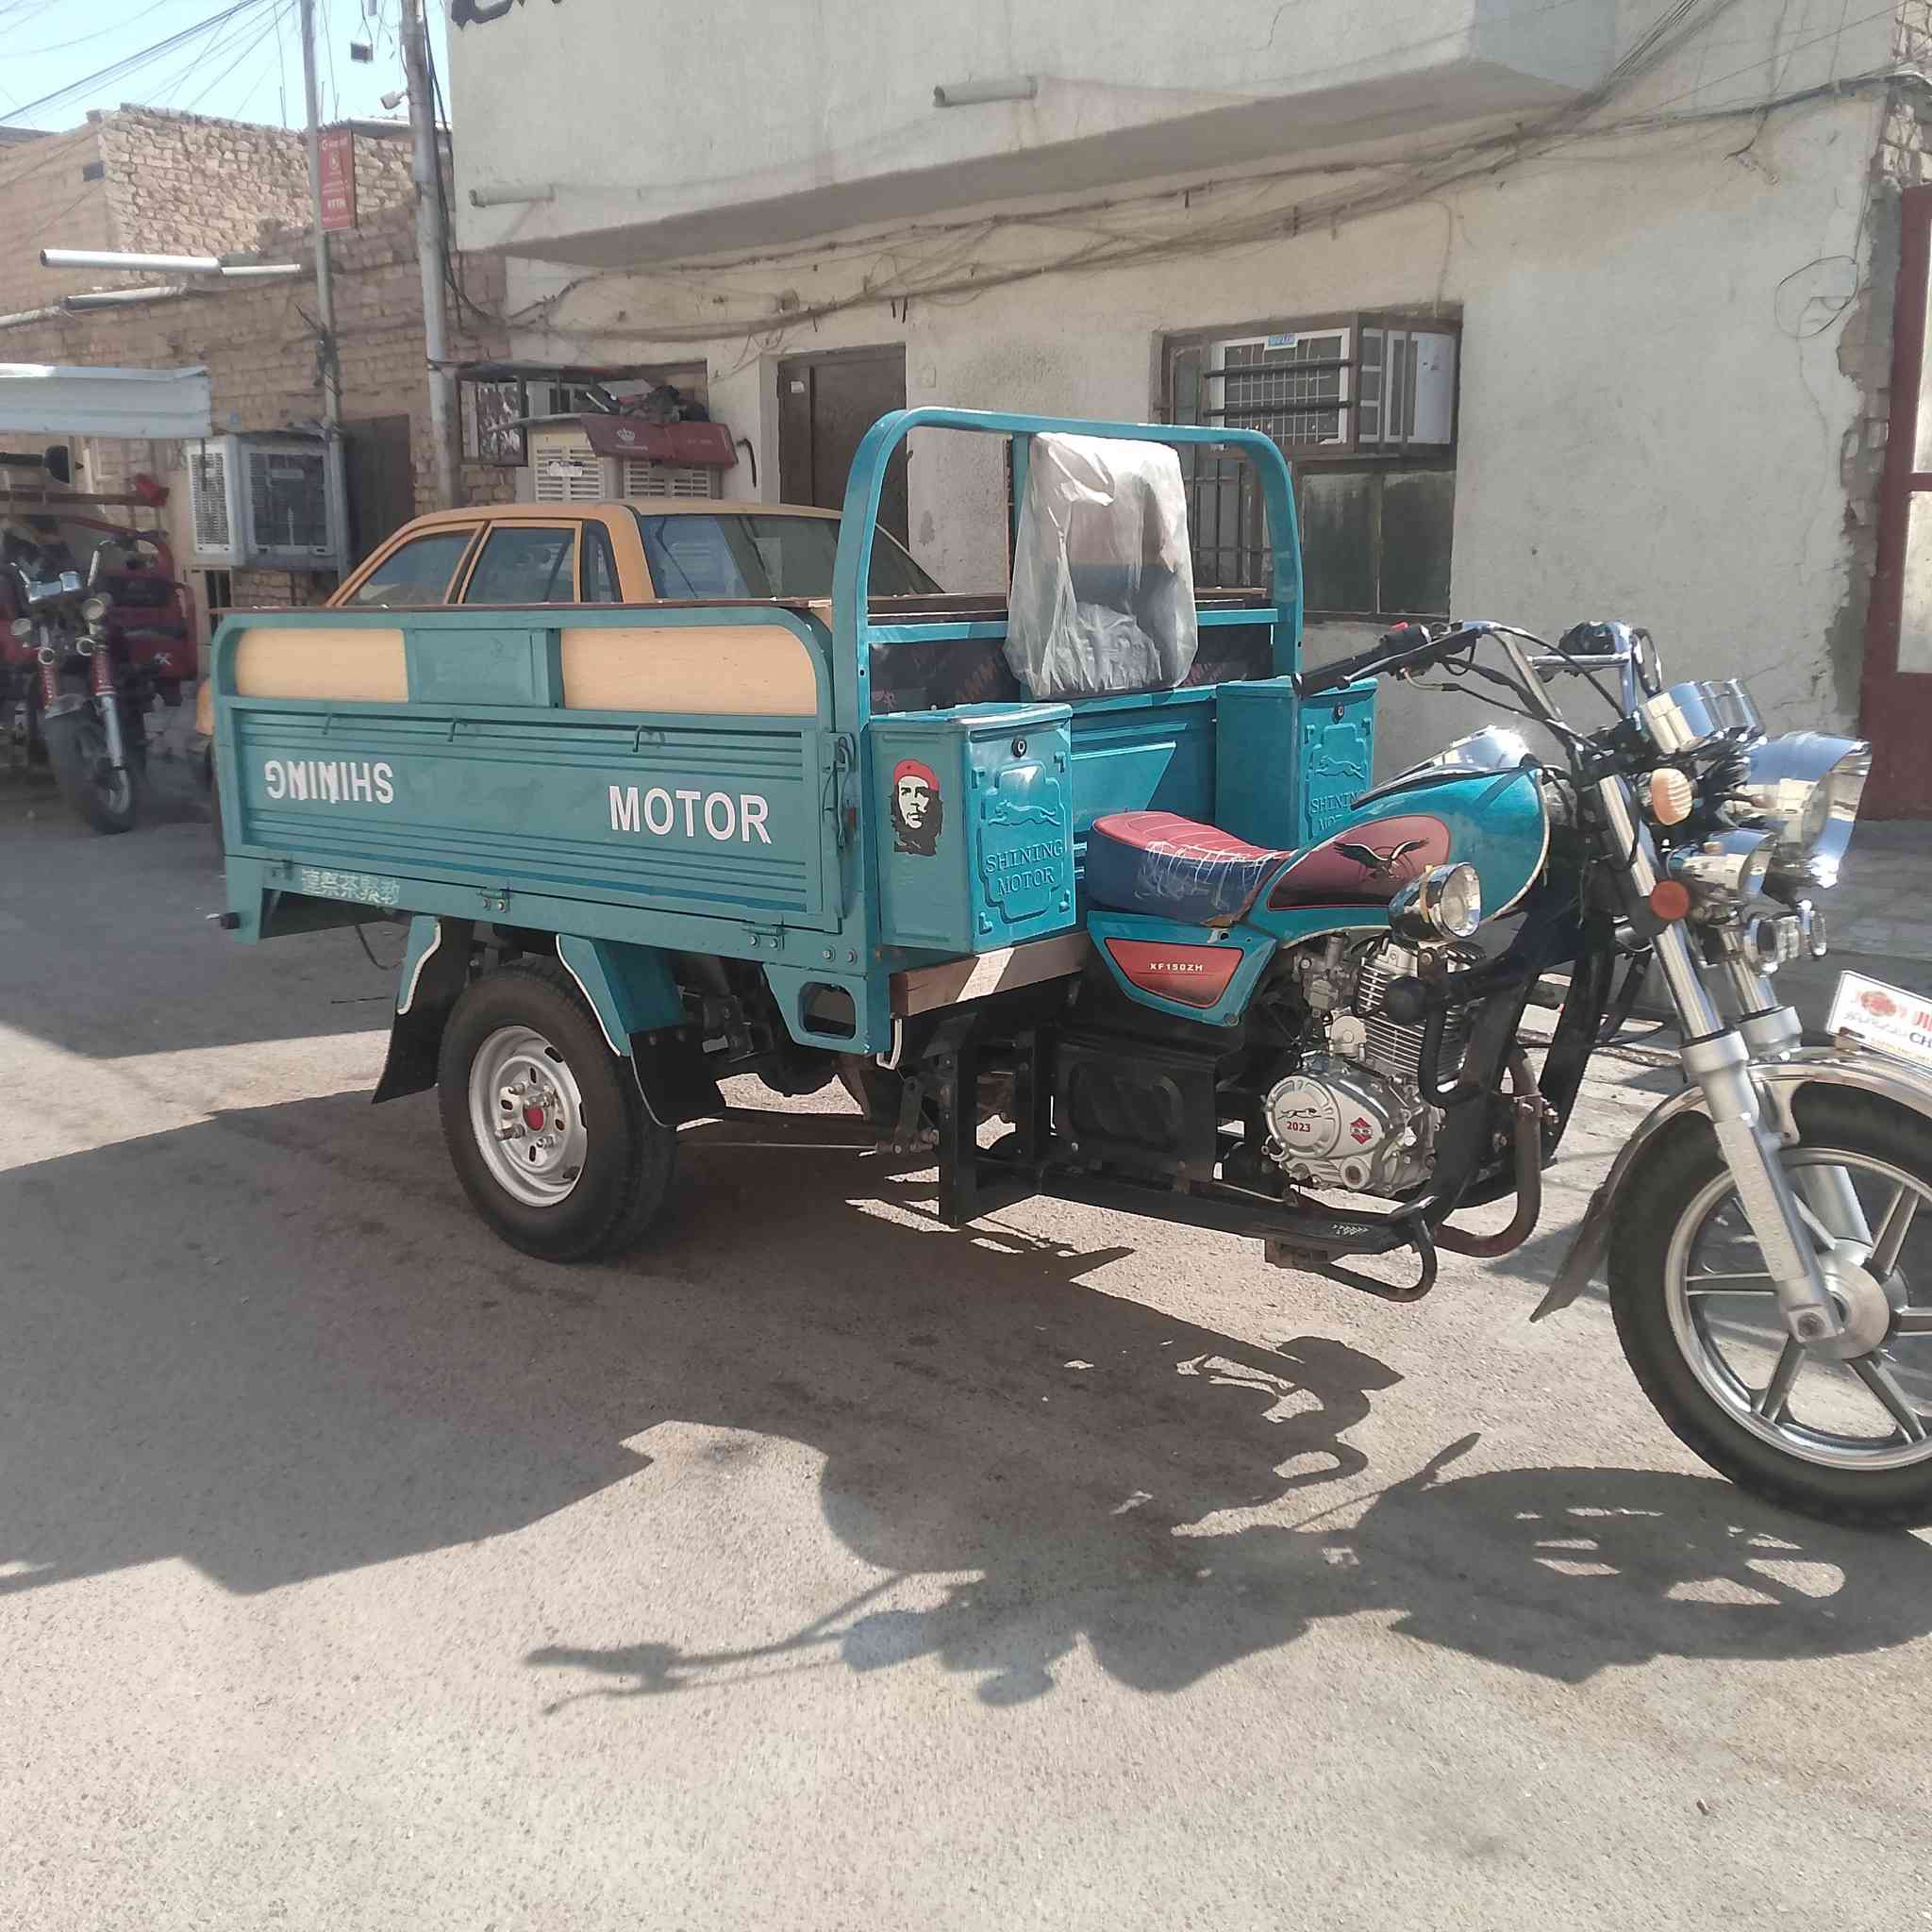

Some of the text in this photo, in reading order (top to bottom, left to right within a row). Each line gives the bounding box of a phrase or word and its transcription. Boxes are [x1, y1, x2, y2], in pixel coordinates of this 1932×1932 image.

[264, 759, 394, 805] SHINING
[608, 784, 773, 845] MOTOR
[986, 839, 1063, 874] SHINING
[997, 865, 1055, 896] MOTOR
[1286, 1121, 1311, 1133] 2023
